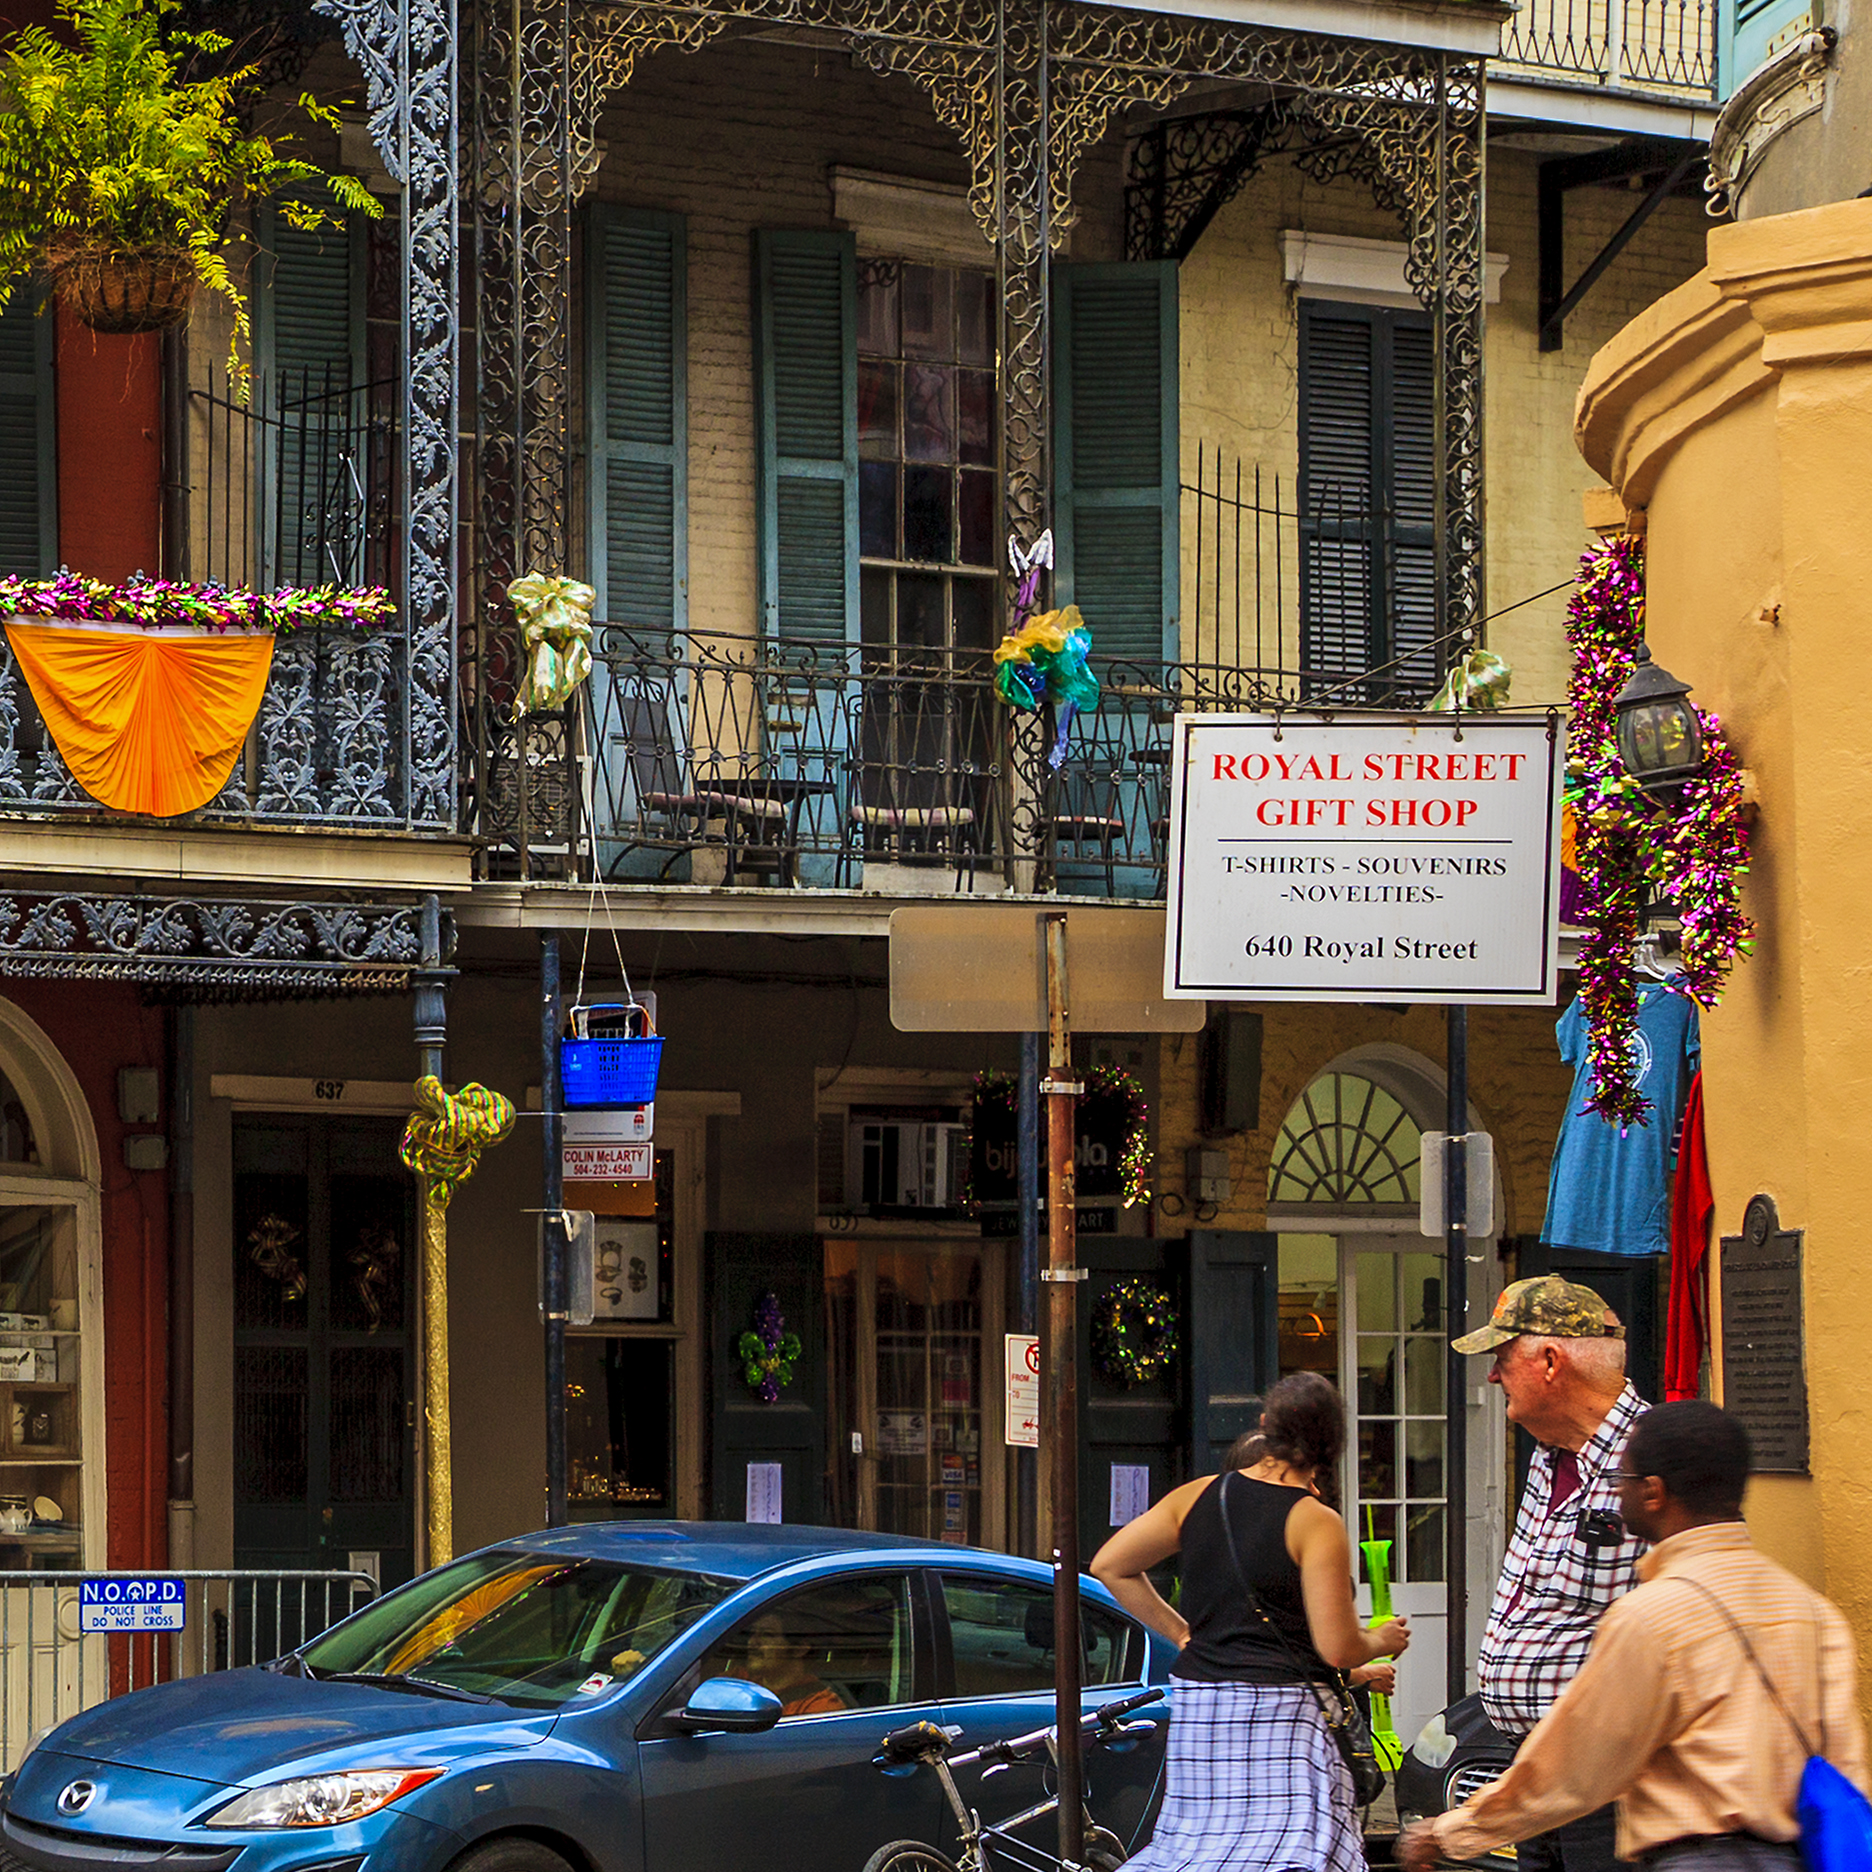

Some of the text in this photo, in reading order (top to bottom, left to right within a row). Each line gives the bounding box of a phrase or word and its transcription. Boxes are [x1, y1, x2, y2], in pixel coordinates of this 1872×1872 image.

[1212, 753, 1527, 781] ROYAL STREET
[1256, 798, 1478, 827] GIFT SHOP
[1222, 856, 1336, 875] T-SHIRTS
[1357, 856, 1508, 877] SOUVENIRS
[1280, 885, 1444, 904] -NOVELTIES-
[1245, 935, 1479, 965] 640 Royal Street
[316, 1081, 344, 1100] 637
[564, 1150, 644, 1164] COLIN McLARTY
[1078, 1213, 1104, 1228] ART
[1011, 1373, 1030, 1382] FROM
[83, 1581, 182, 1602] N.O. P.D.
[104, 1605, 163, 1616] POLICE LINE
[92, 1615, 174, 1627] DO NOT CROSS
